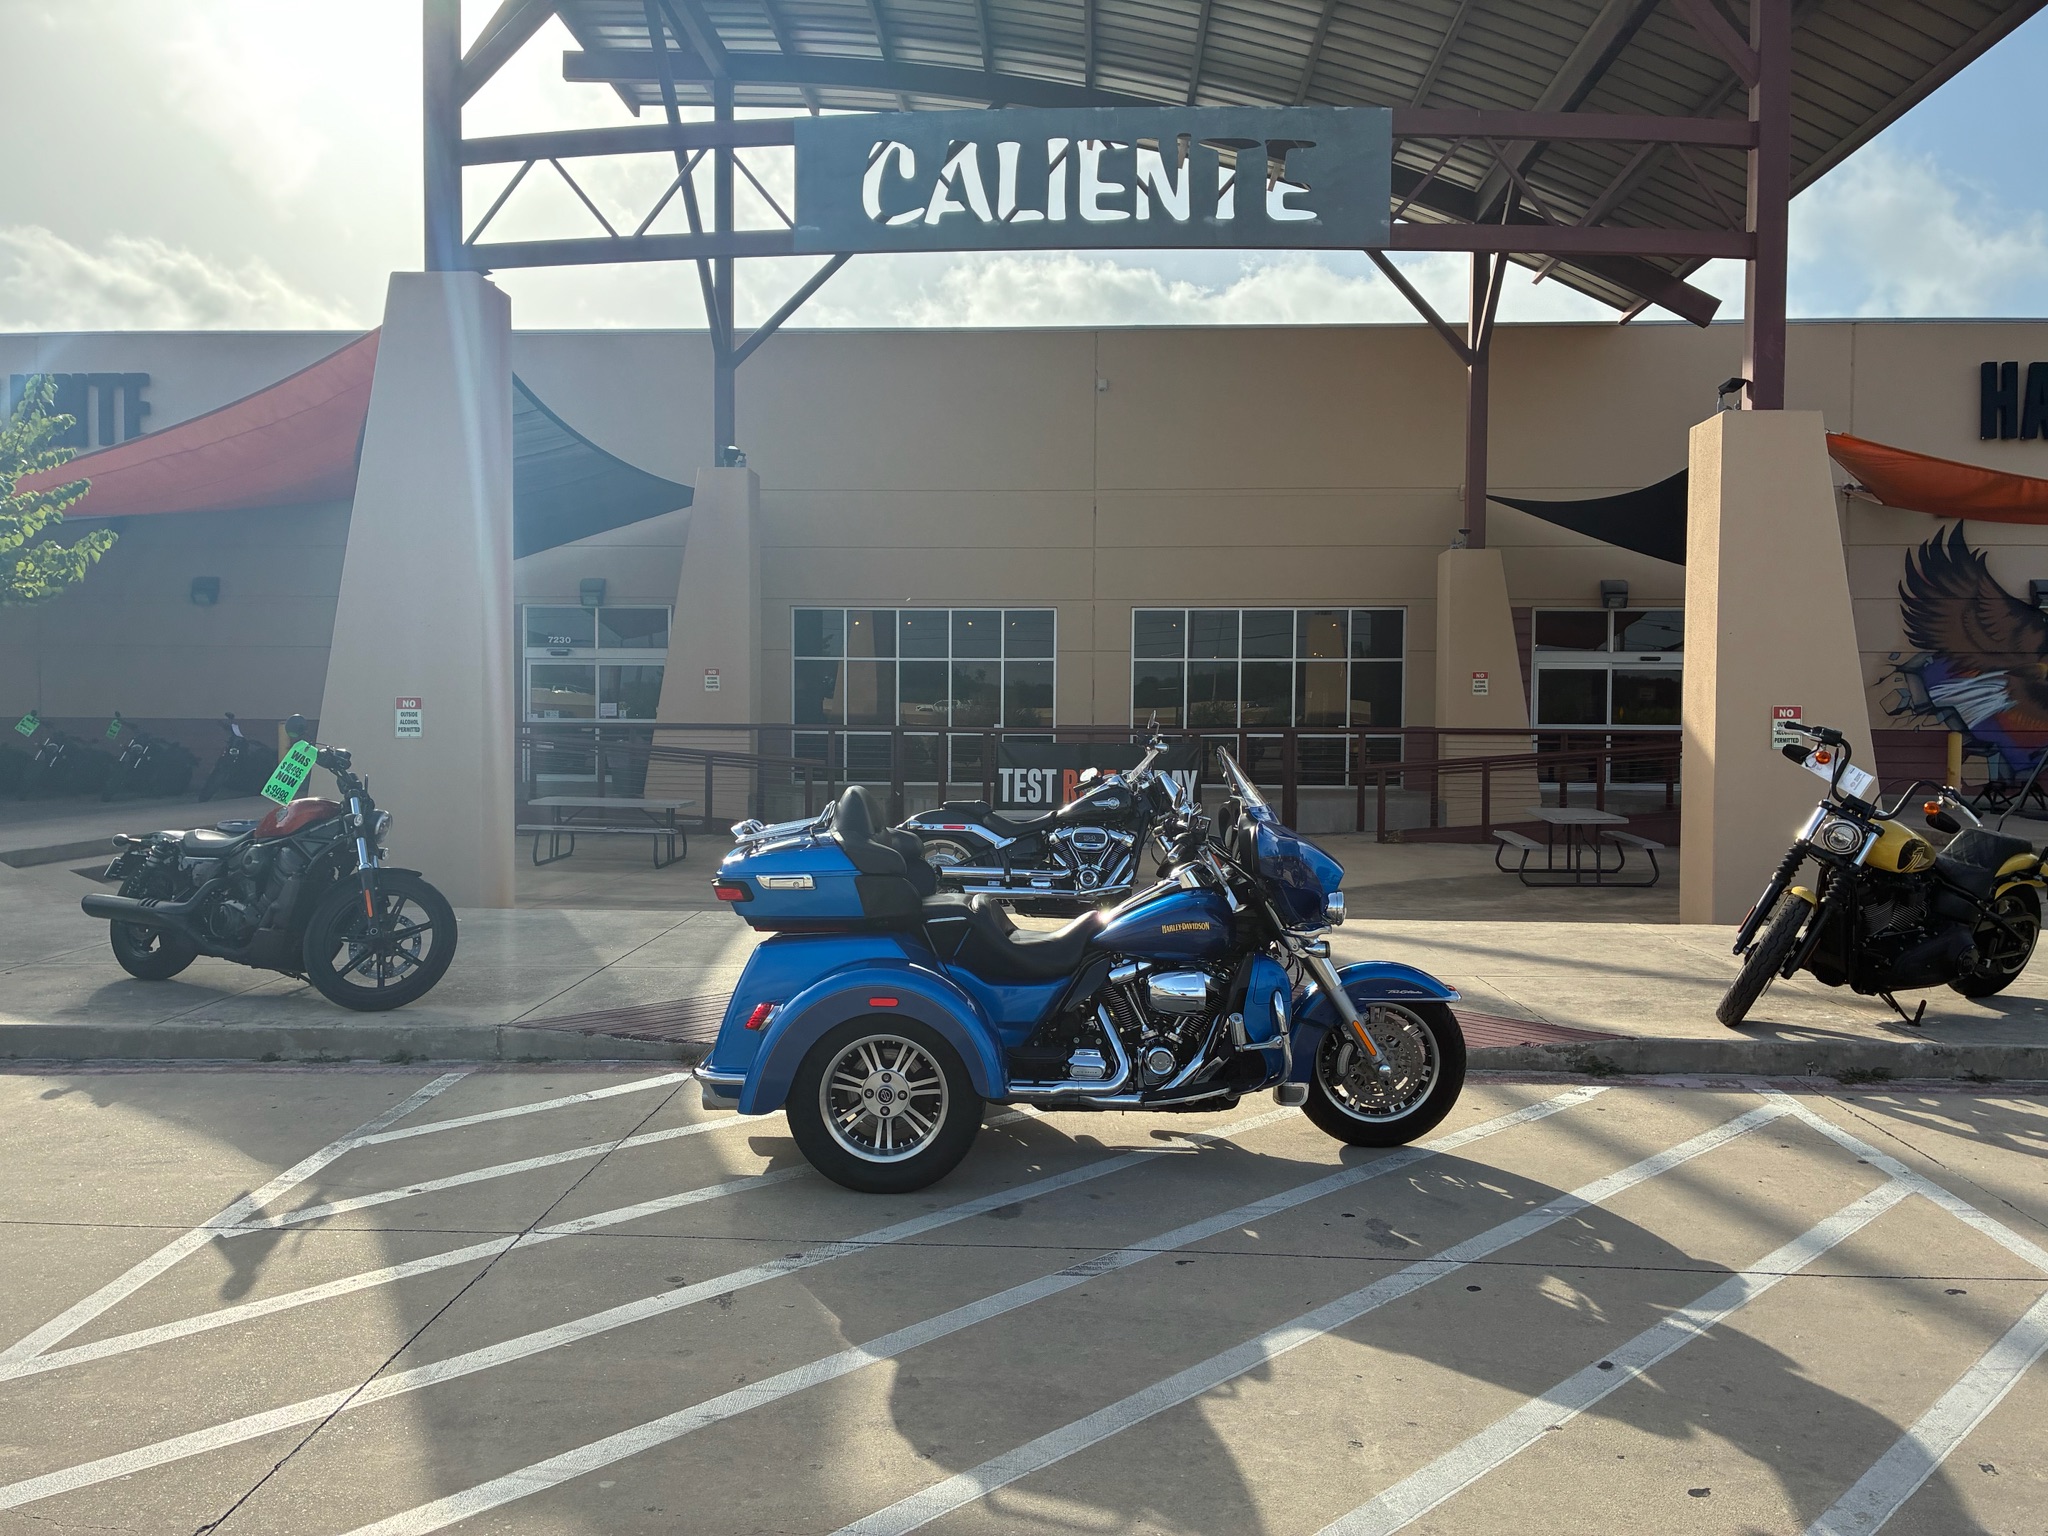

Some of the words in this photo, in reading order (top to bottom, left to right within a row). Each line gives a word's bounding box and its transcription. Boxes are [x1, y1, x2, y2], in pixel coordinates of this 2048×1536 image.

[862, 132, 1317, 226] CALIENTE
[547, 636, 572, 644] 7230
[402, 699, 416, 708] NO
[1779, 709, 1794, 718] NO
[291, 750, 311, 767] WAS
[275, 771, 298, 788] NOW
[998, 768, 1058, 803] TEST
